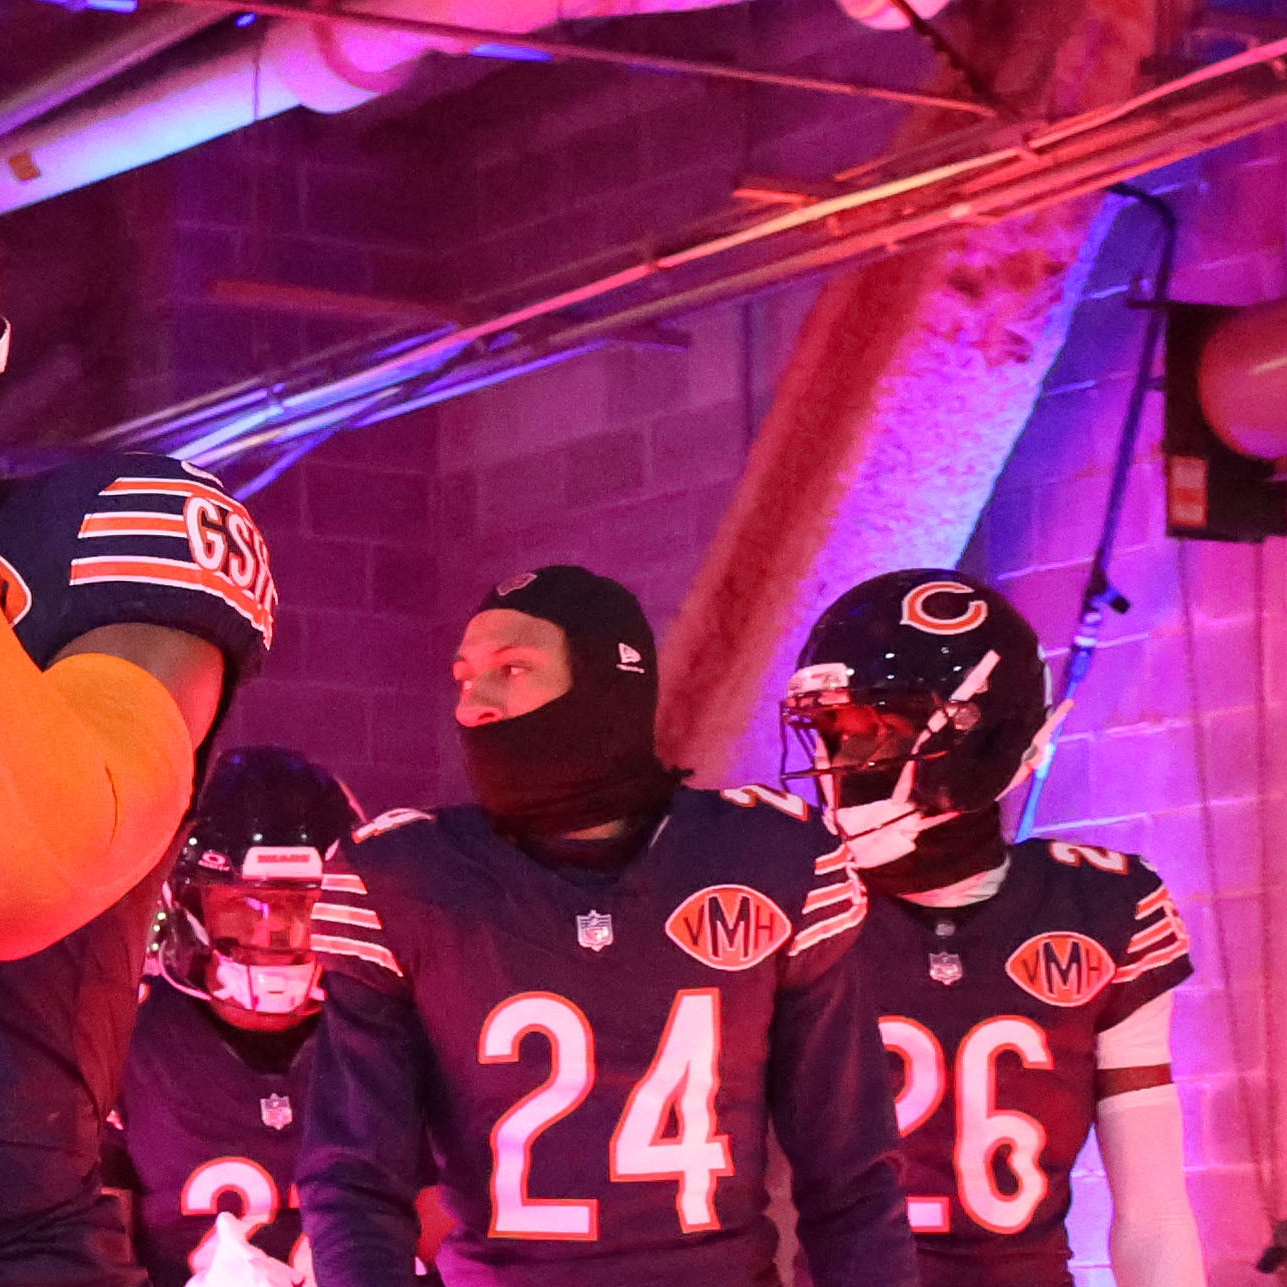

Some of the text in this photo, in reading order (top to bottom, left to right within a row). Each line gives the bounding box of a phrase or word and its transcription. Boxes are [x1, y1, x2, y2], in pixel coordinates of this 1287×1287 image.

[900, 580, 988, 636] C
[682, 893, 775, 961] VMH
[1021, 940, 1103, 998] VMH
[476, 987, 735, 1242] 24
[878, 1014, 1055, 1235] 26
